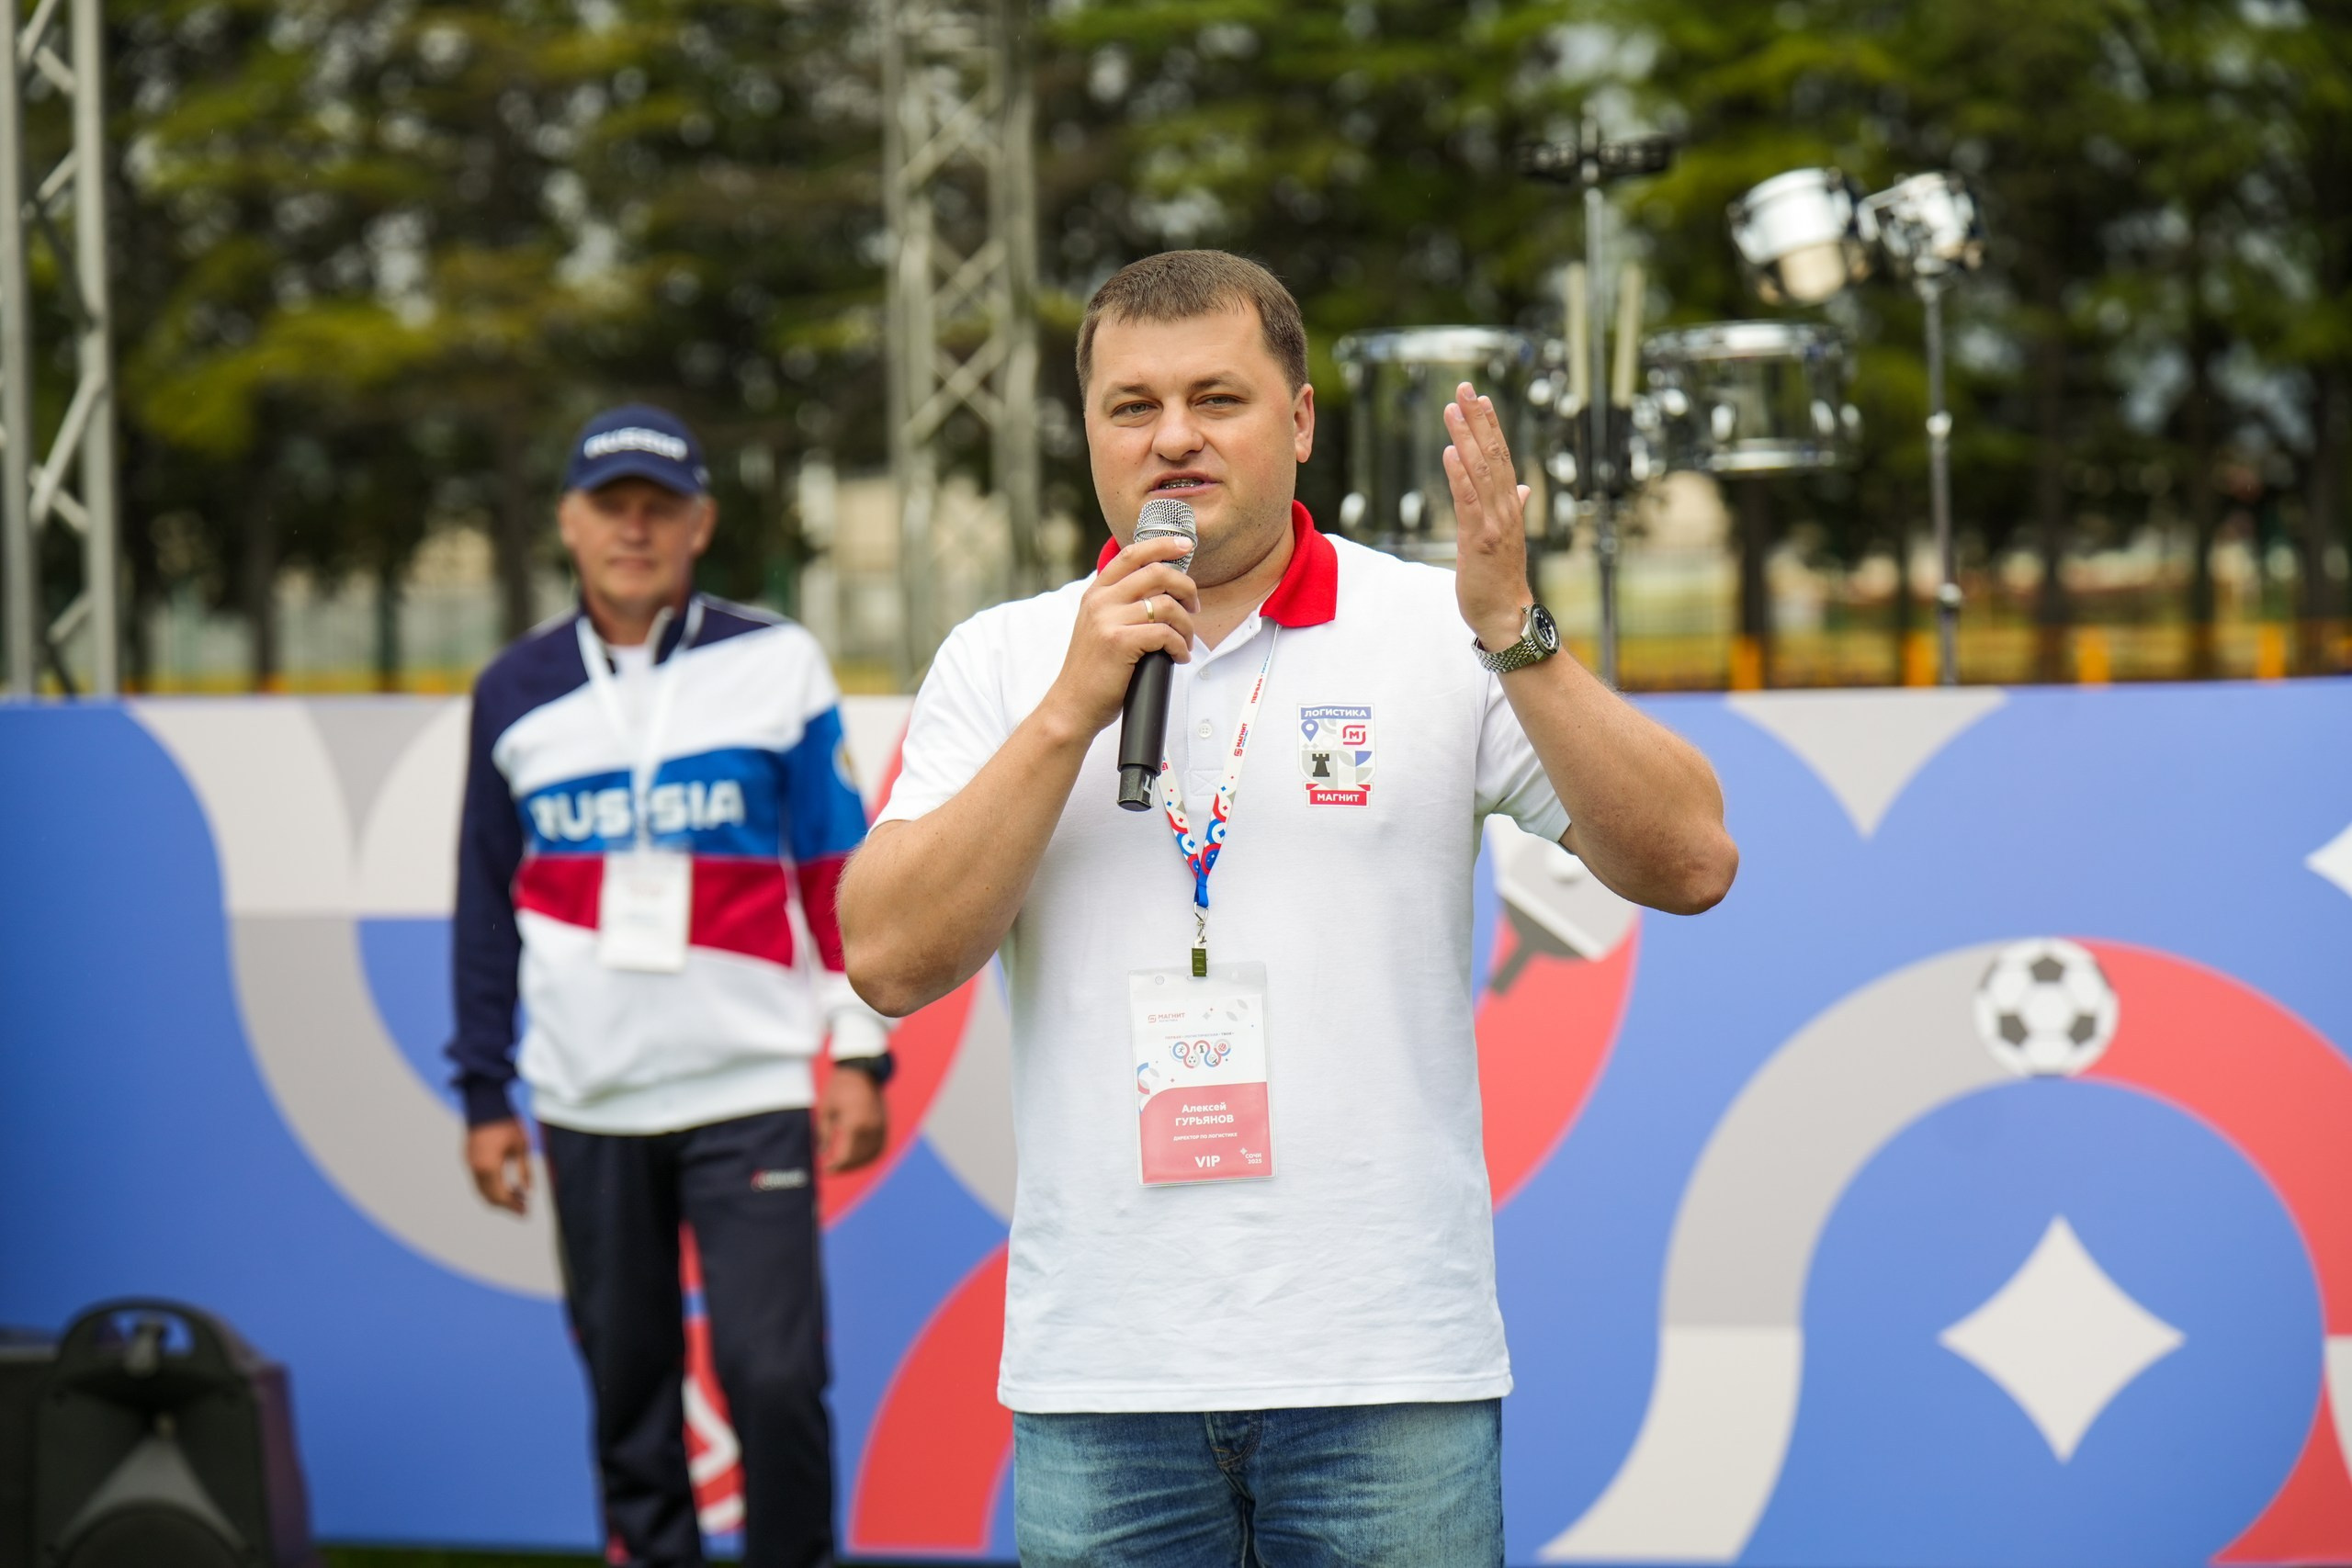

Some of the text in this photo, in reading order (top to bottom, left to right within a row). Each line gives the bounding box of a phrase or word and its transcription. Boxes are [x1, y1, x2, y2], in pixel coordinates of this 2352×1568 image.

[1305, 708, 1367, 717] ЛОГИСТИКА
[1236, 723, 1248, 748] МАГНИТ
[1317, 794, 1360, 802] МАГНИТ
[1182, 1101, 1227, 1113] Алексей
[1175, 1114, 1234, 1126] ГУРЬЯНОВ
[1194, 1156, 1221, 1168] VIP
